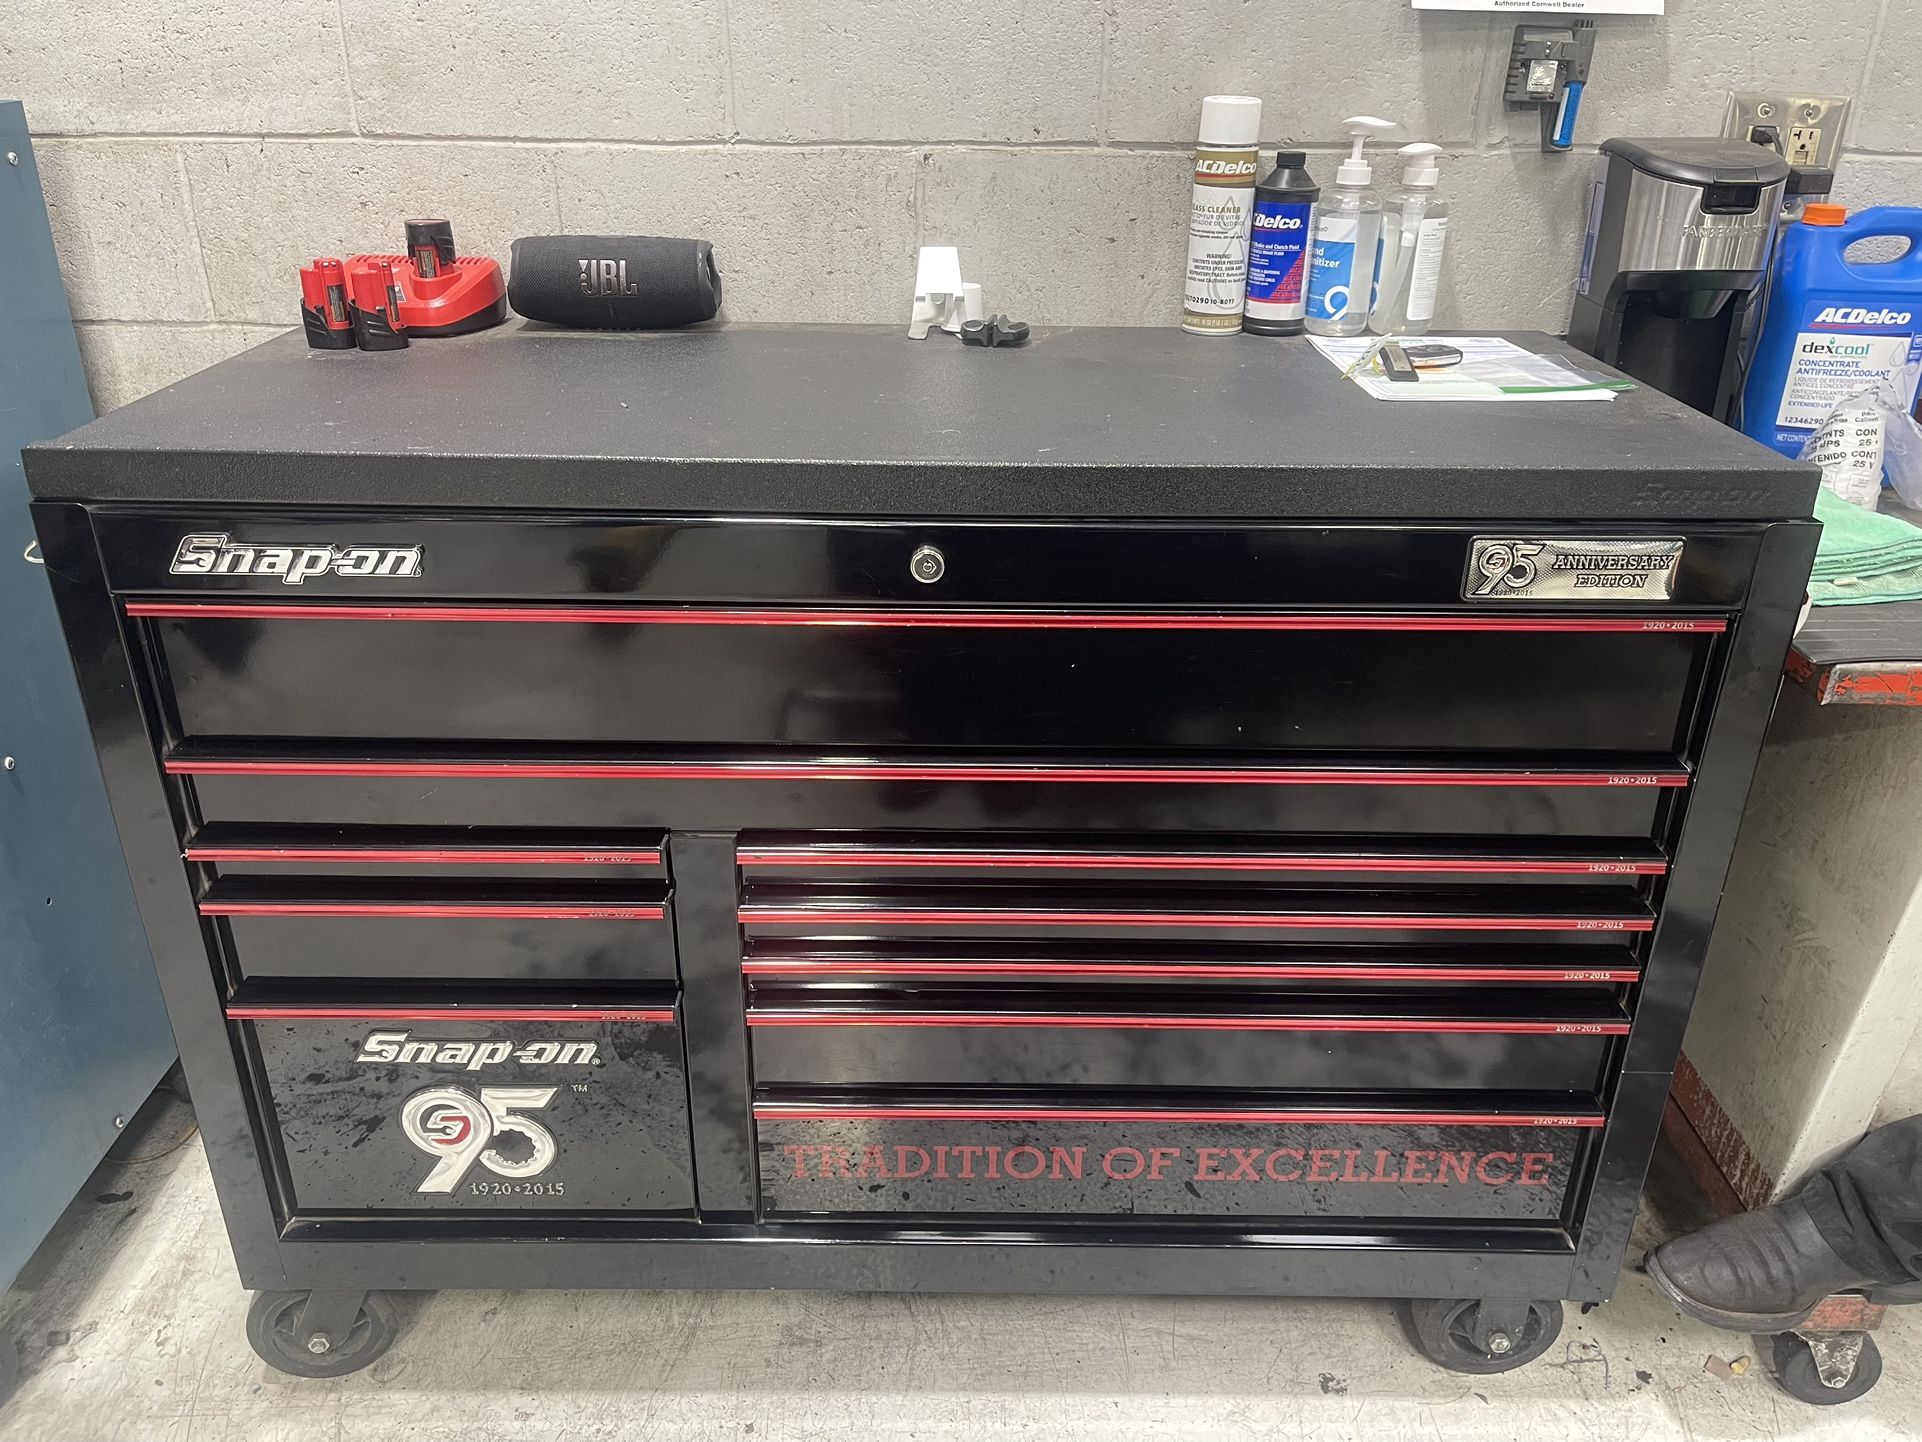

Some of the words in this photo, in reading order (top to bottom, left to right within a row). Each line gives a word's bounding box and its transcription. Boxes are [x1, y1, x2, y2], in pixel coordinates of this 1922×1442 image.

[1195, 159, 1257, 175] ACDelco
[579, 259, 638, 296] JBL
[1813, 307, 1912, 325] ACDelco
[1801, 341, 1871, 356] dexcool
[1798, 359, 1862, 368] CONCENTRATE
[1796, 367, 1891, 378] ANTIFREEZE/COOLANT
[1784, 416, 1824, 425] 12346290
[1855, 428, 1878, 437] CON
[170, 533, 424, 585] Snap-on
[1473, 543, 1547, 595] 95
[1551, 555, 1674, 571] ANNIVERSARY
[1574, 573, 1649, 588] EDITION
[356, 1030, 599, 1071] Snap-on
[401, 1085, 559, 1193] 95
[783, 1144, 1088, 1181] TRADITION
[1102, 1145, 1181, 1181] OF
[1193, 1147, 1555, 1186] EXCELLENCE
